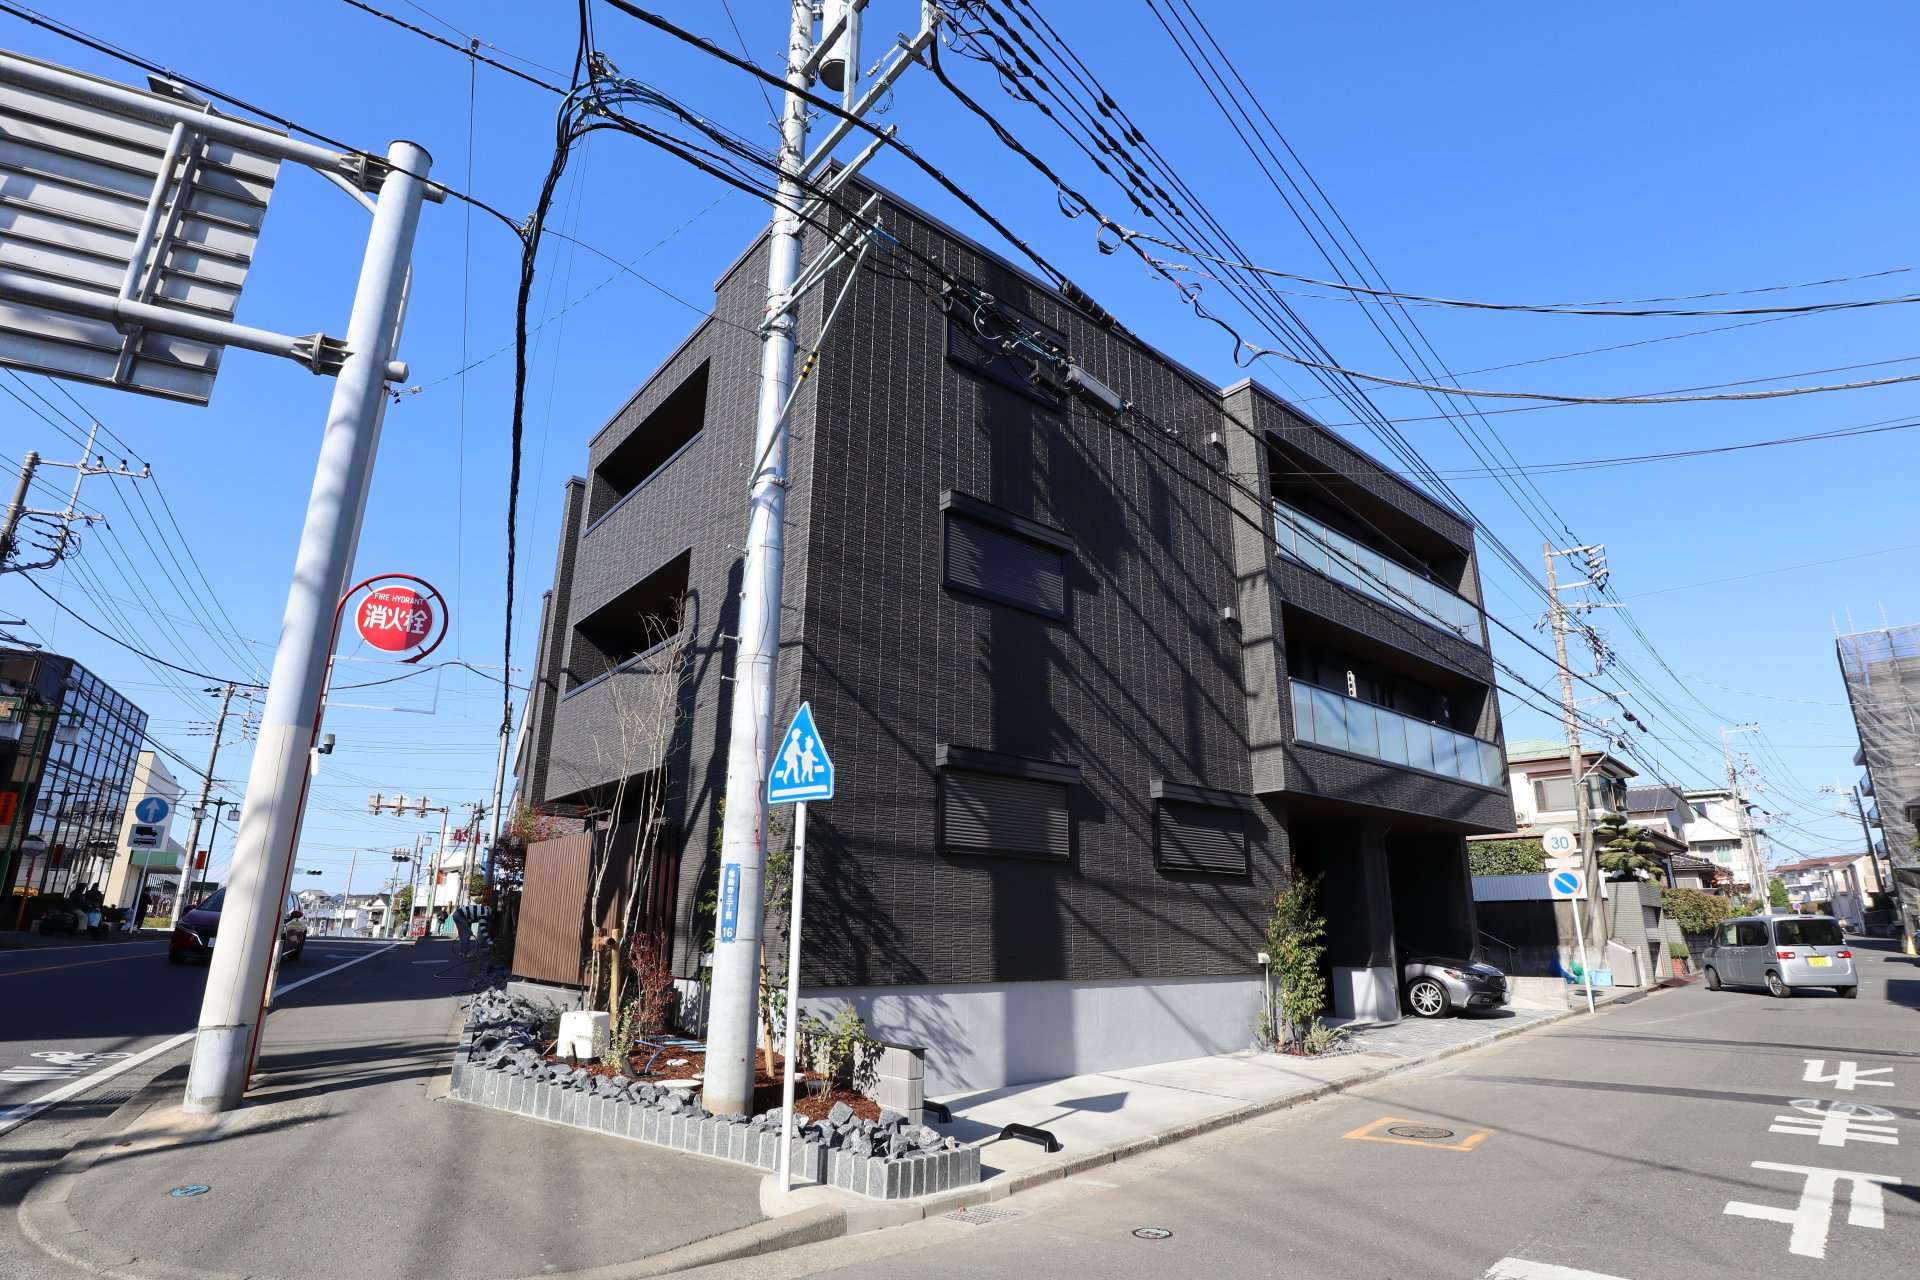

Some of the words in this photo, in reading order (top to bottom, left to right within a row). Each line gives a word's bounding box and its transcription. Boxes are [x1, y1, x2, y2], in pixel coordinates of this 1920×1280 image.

[374, 593, 390, 601] FIRE
[392, 595, 424, 605] HYDRANT
[363, 603, 428, 635] 消火栓
[1551, 836, 1569, 850] 30
[722, 927, 733, 938] 16
